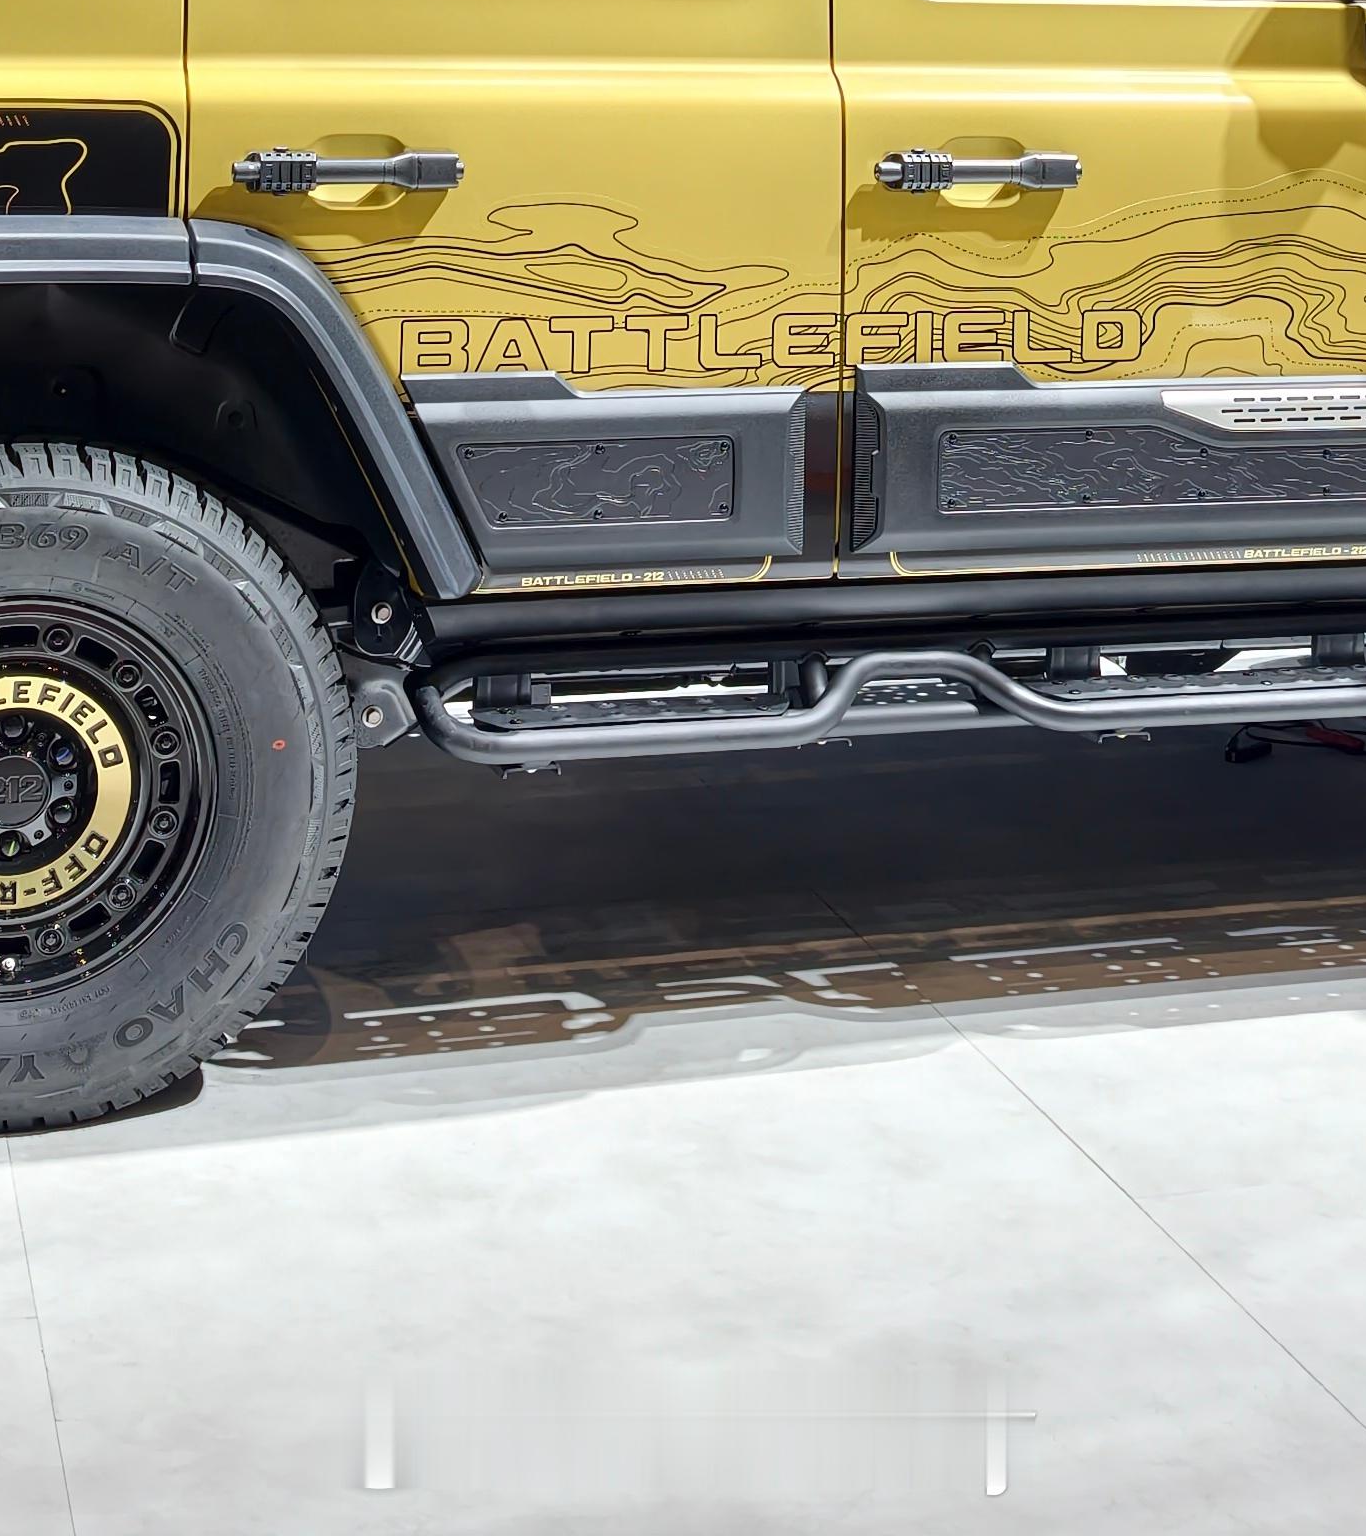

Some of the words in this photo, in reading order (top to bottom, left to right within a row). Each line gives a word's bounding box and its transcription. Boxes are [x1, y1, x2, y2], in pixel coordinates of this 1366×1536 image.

[400, 308, 1143, 374] BATTLEFIELD
[102, 540, 199, 592] A/T
[521, 572, 633, 587] BATTLEFIELD
[643, 571, 665, 582] 212
[1244, 547, 1342, 559] BATTLEFIELD
[113, 921, 249, 1049] CHAO
